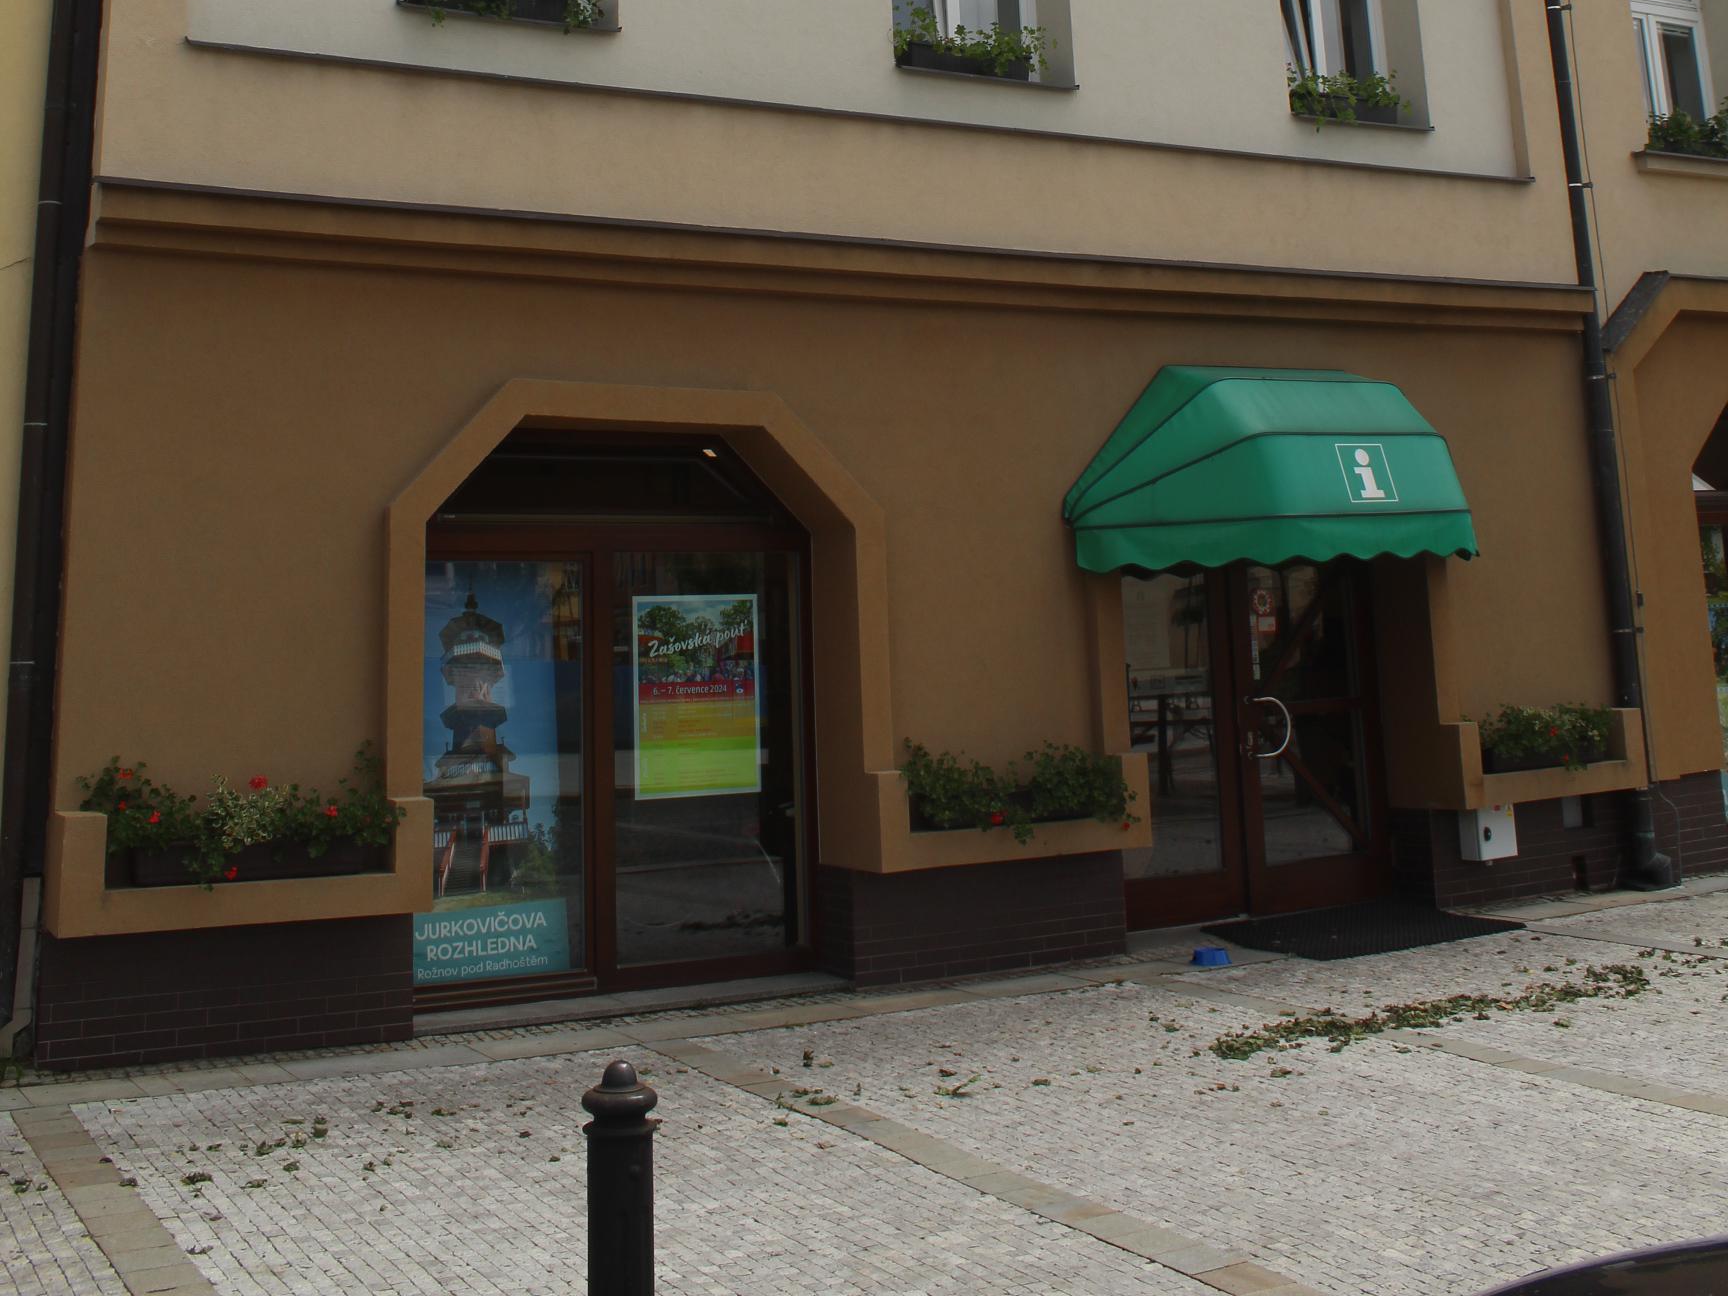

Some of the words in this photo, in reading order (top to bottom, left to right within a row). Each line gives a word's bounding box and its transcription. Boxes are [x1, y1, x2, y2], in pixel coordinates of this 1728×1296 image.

[648, 630, 711, 657] Zašovská
[714, 620, 748, 648] pouť
[675, 685, 708, 695] července
[710, 684, 727, 693] 2024
[415, 911, 547, 940] JURKOVIČOVA
[427, 934, 537, 961] ROZHLEDNA
[417, 967, 458, 981] Rožnov
[461, 960, 483, 977] pod
[486, 955, 548, 971] Radhoštěm
